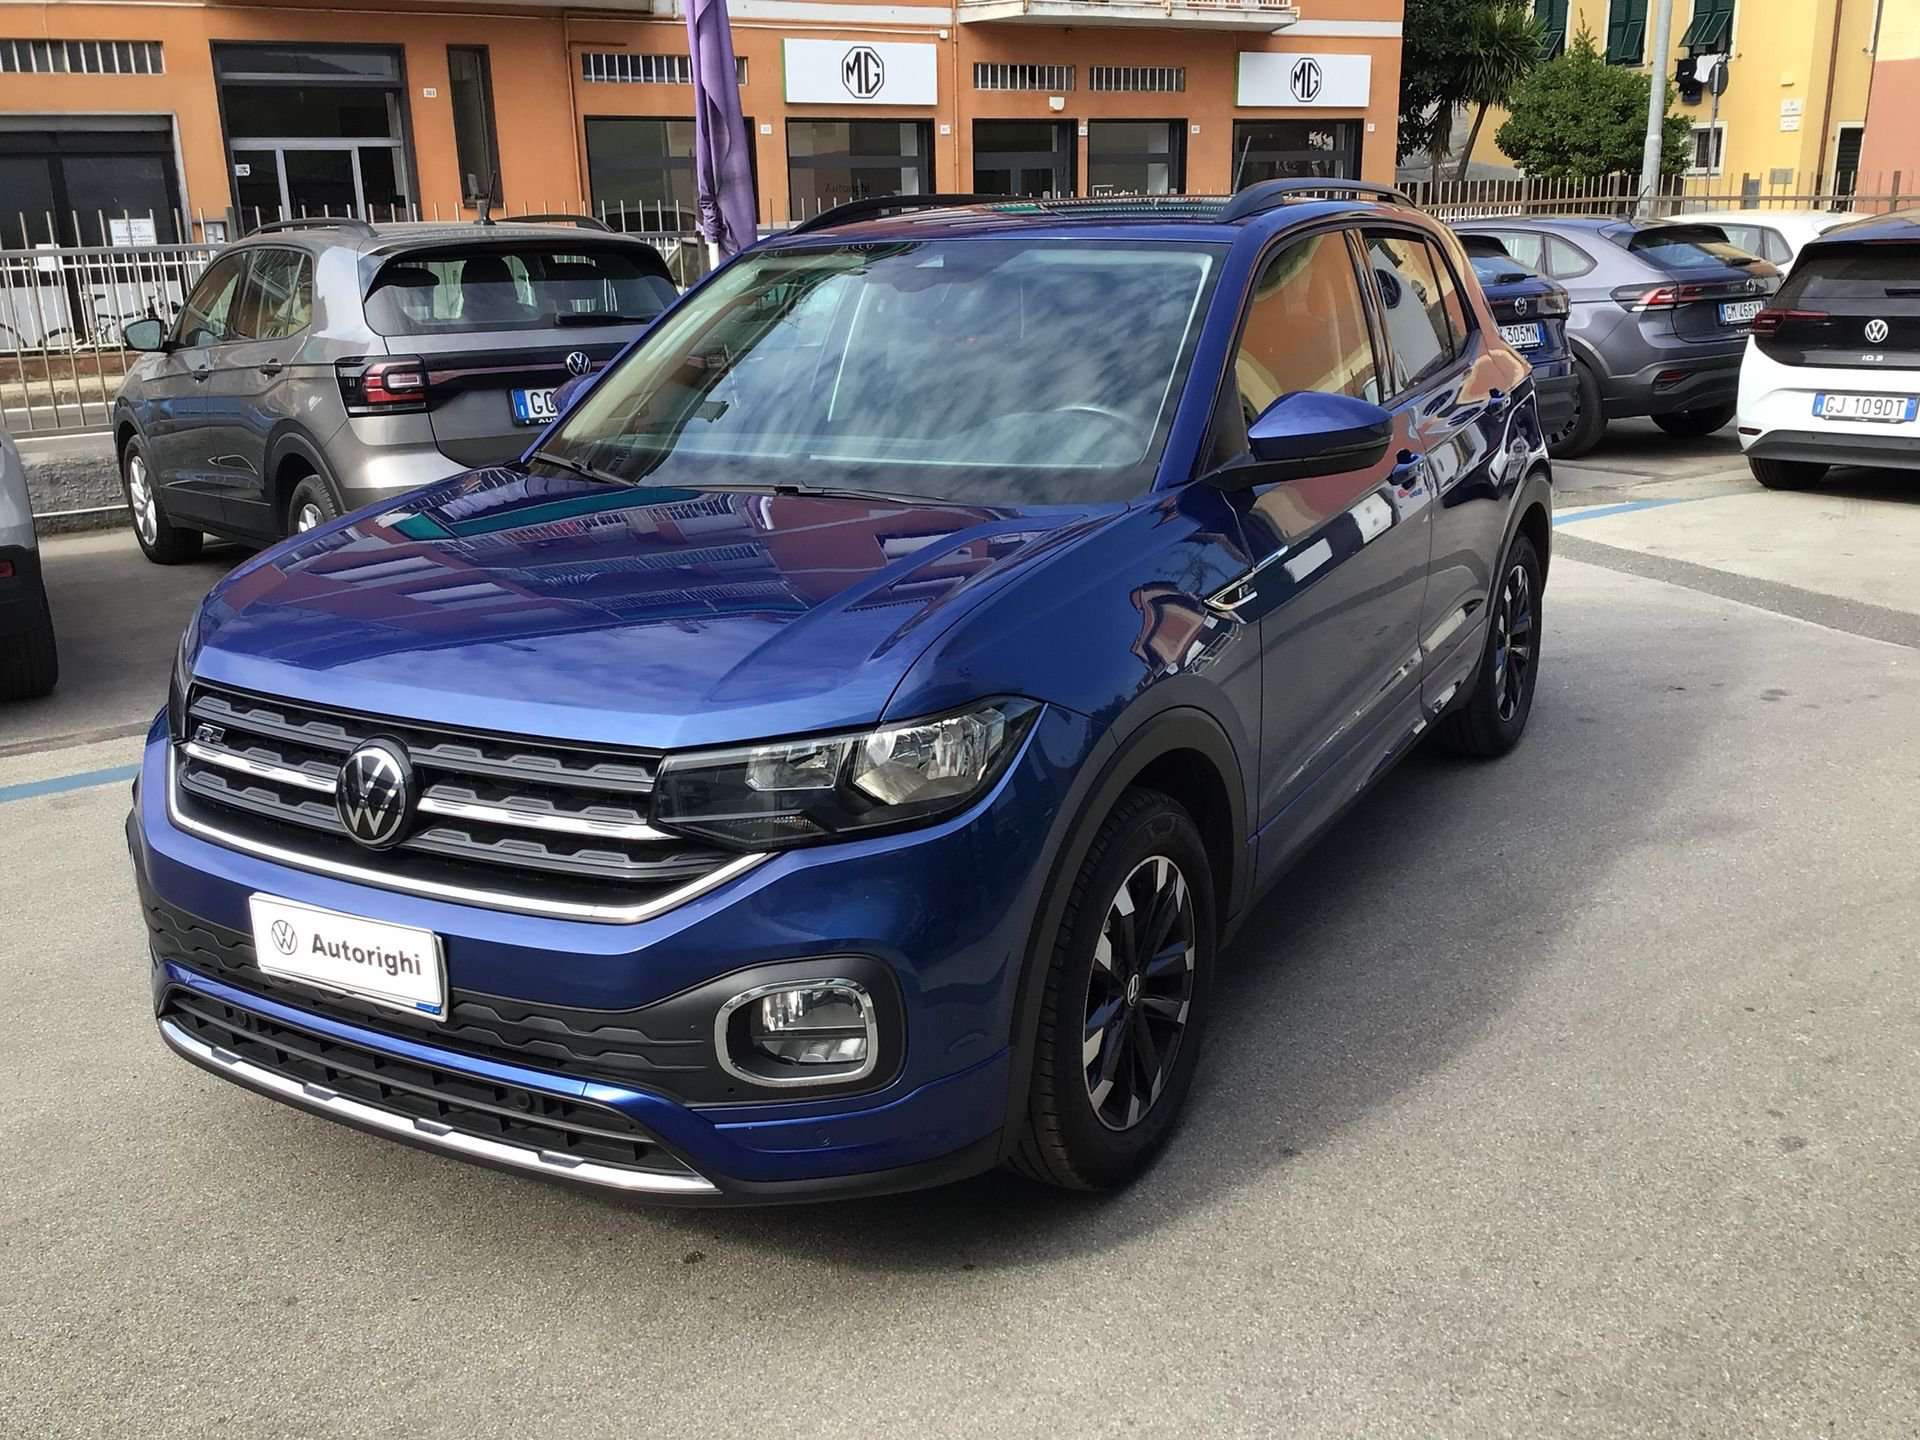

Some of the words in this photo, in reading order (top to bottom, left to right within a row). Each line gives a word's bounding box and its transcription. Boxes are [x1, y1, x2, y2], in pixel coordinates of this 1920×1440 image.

[845, 51, 880, 94] MG
[1293, 61, 1319, 98] MG
[1825, 397, 1847, 413] GJ
[1855, 398, 1905, 416] 109DT
[311, 933, 422, 977] Autorighi
